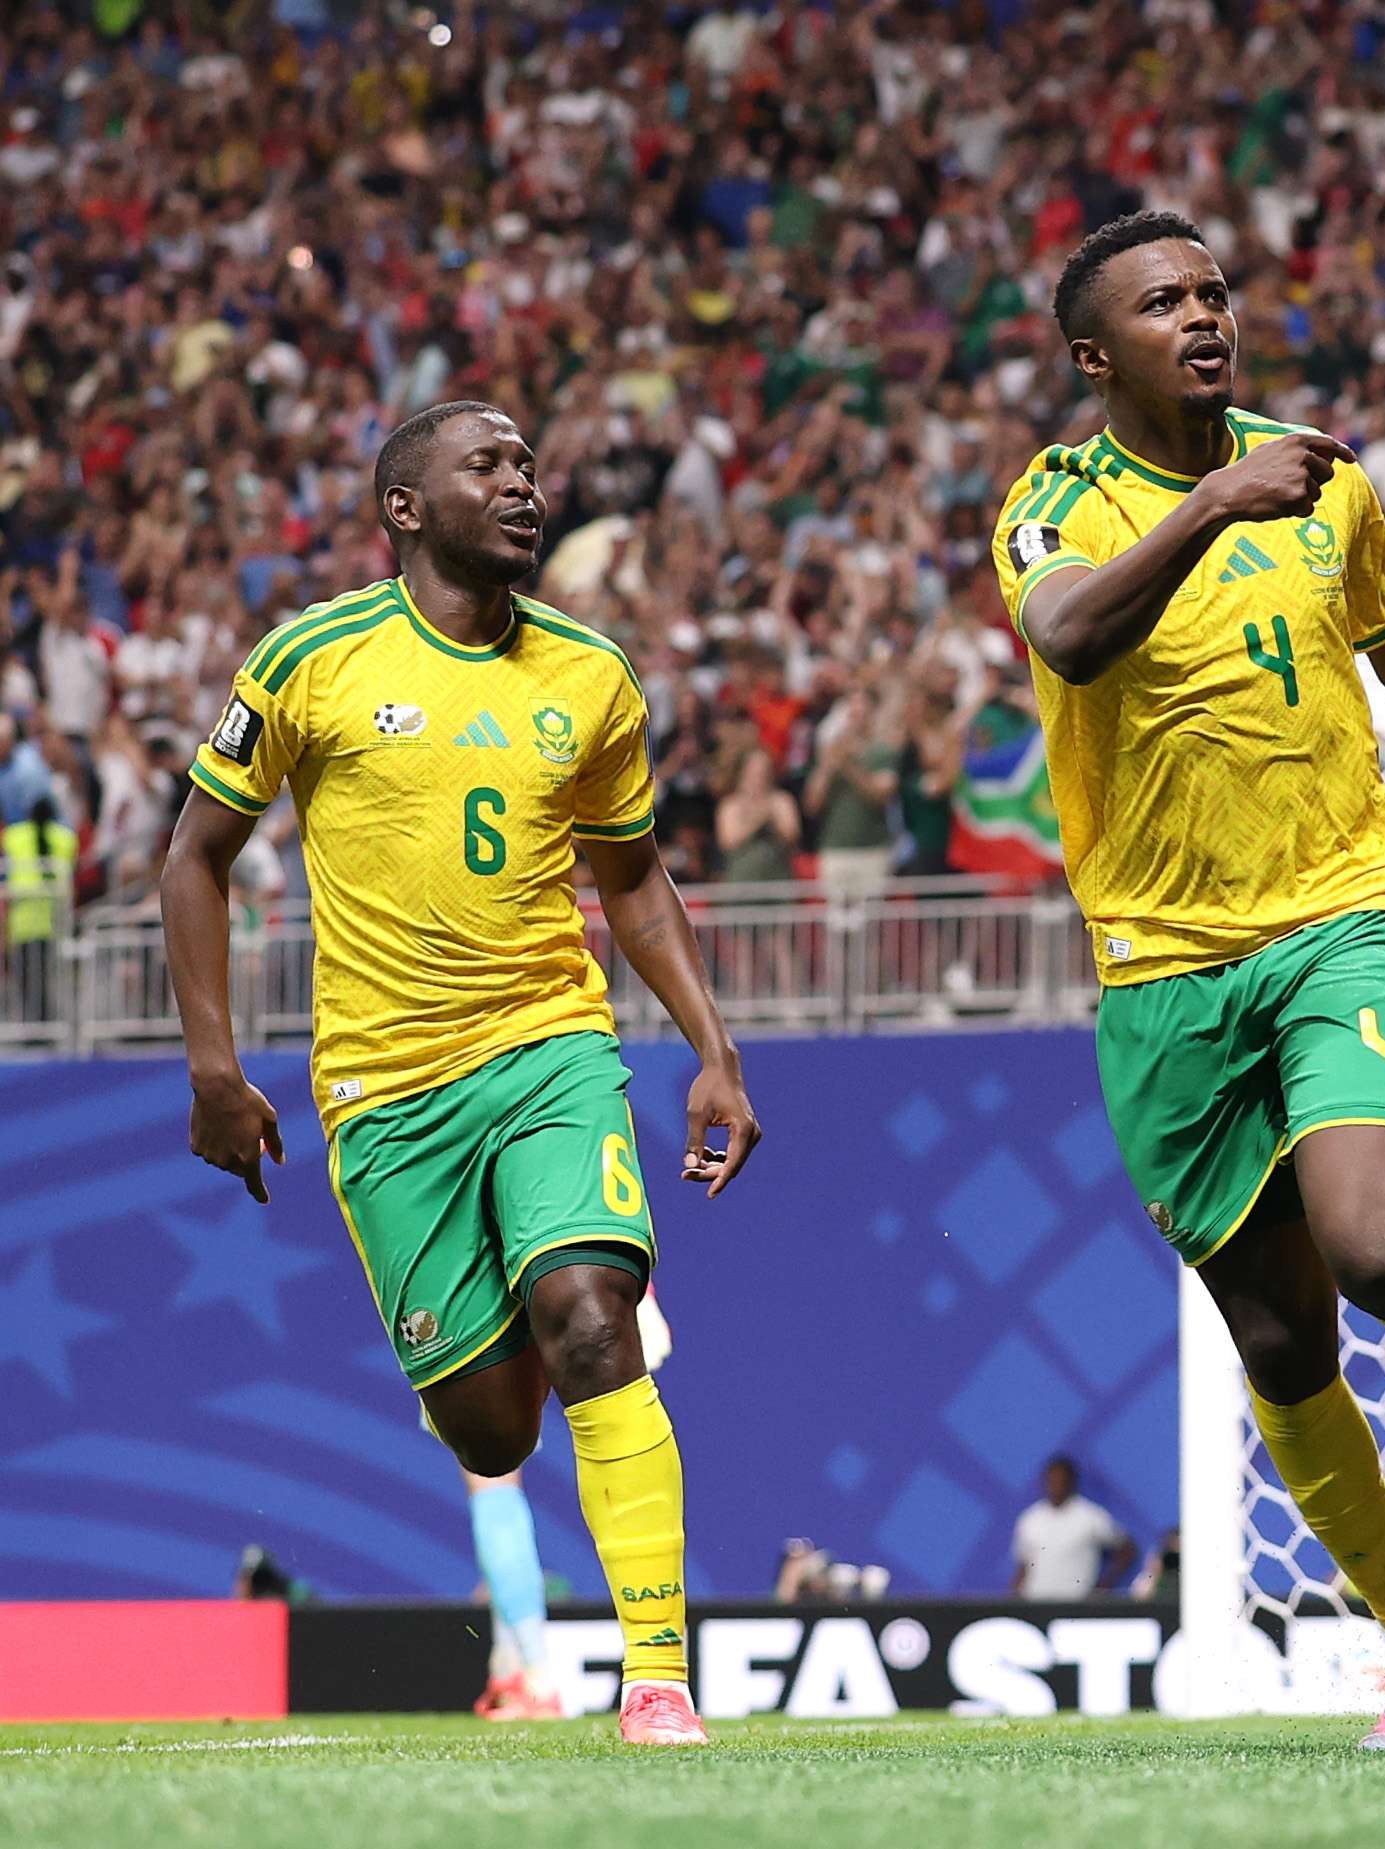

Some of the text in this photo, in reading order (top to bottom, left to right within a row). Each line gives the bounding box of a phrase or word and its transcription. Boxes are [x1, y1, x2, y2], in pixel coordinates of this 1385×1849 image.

[1242, 614, 1300, 707] 4
[464, 787, 507, 876] 6
[602, 1132, 642, 1217] 6
[621, 1581, 683, 1603] SAFA
[540, 1617, 899, 1718] FFA
